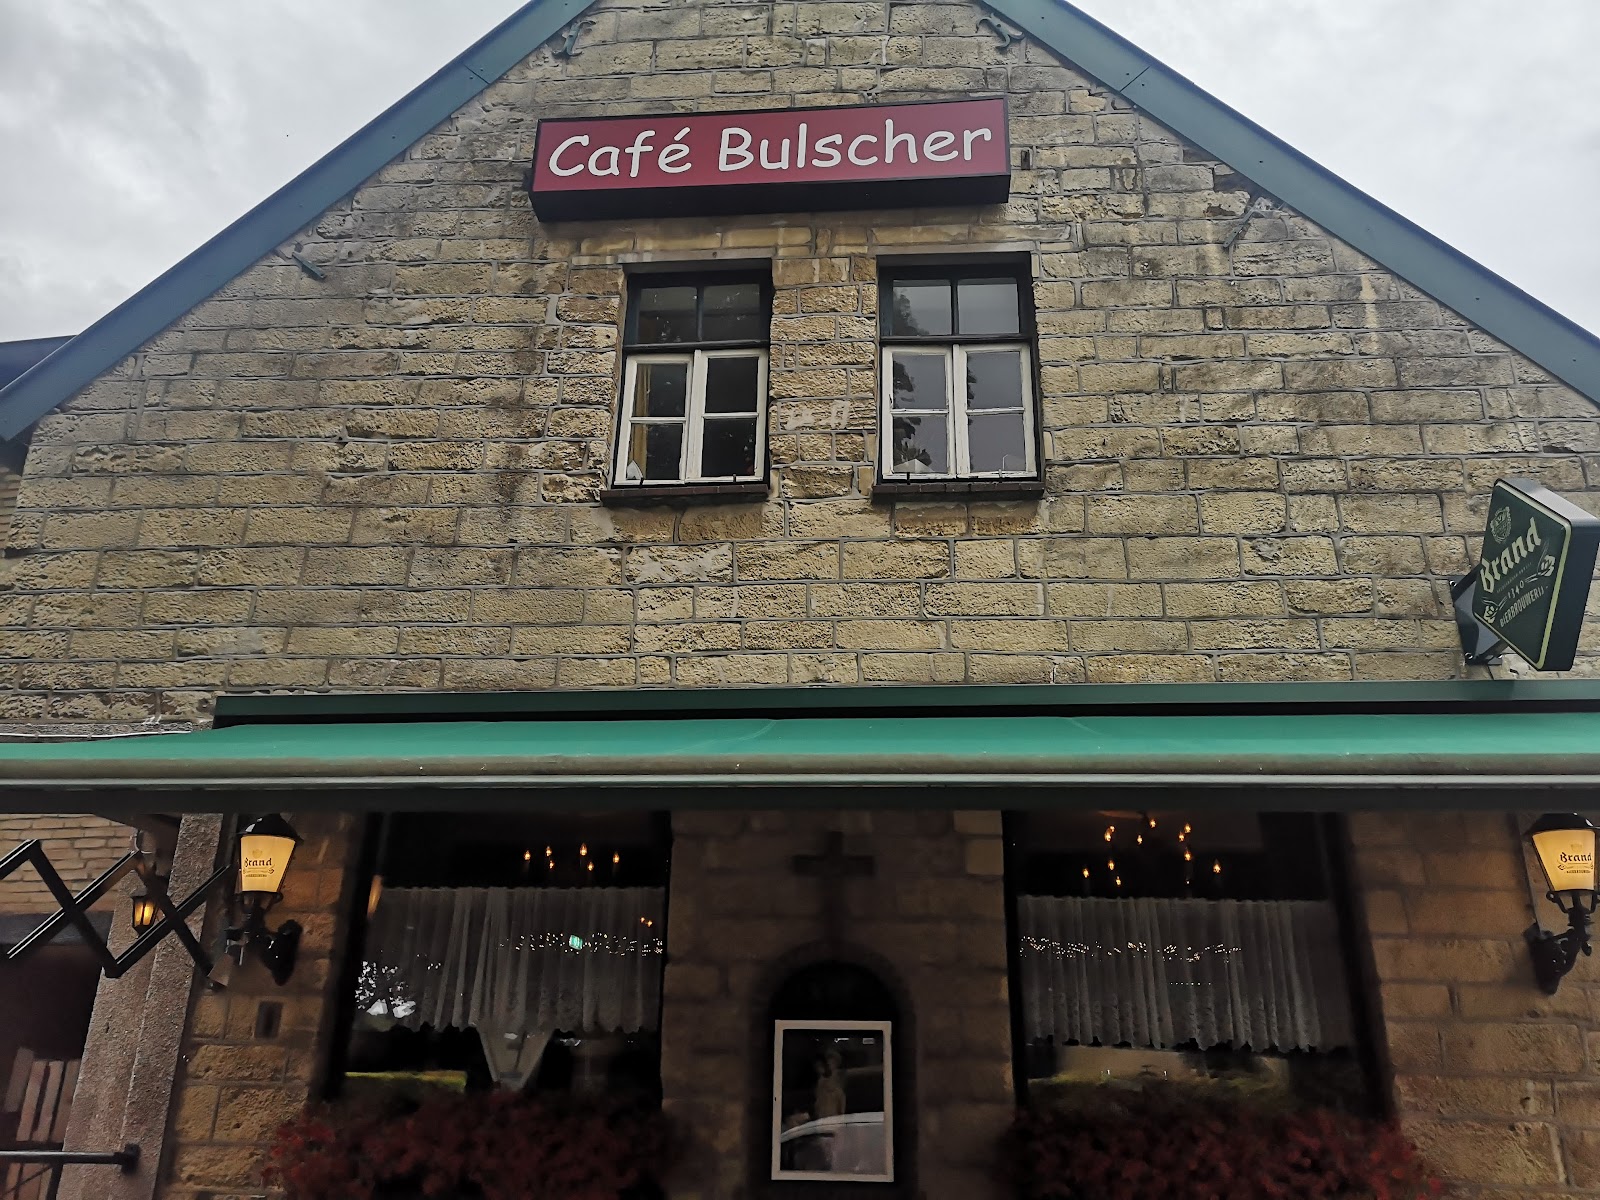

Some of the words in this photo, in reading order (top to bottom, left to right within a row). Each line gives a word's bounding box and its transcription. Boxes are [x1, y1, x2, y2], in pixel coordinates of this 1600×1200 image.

[548, 126, 693, 178] Café
[718, 117, 993, 173] Bulscher
[1479, 516, 1542, 594] Brand
[1507, 579, 1525, 599] 1340
[1560, 851, 1592, 862] Brand
